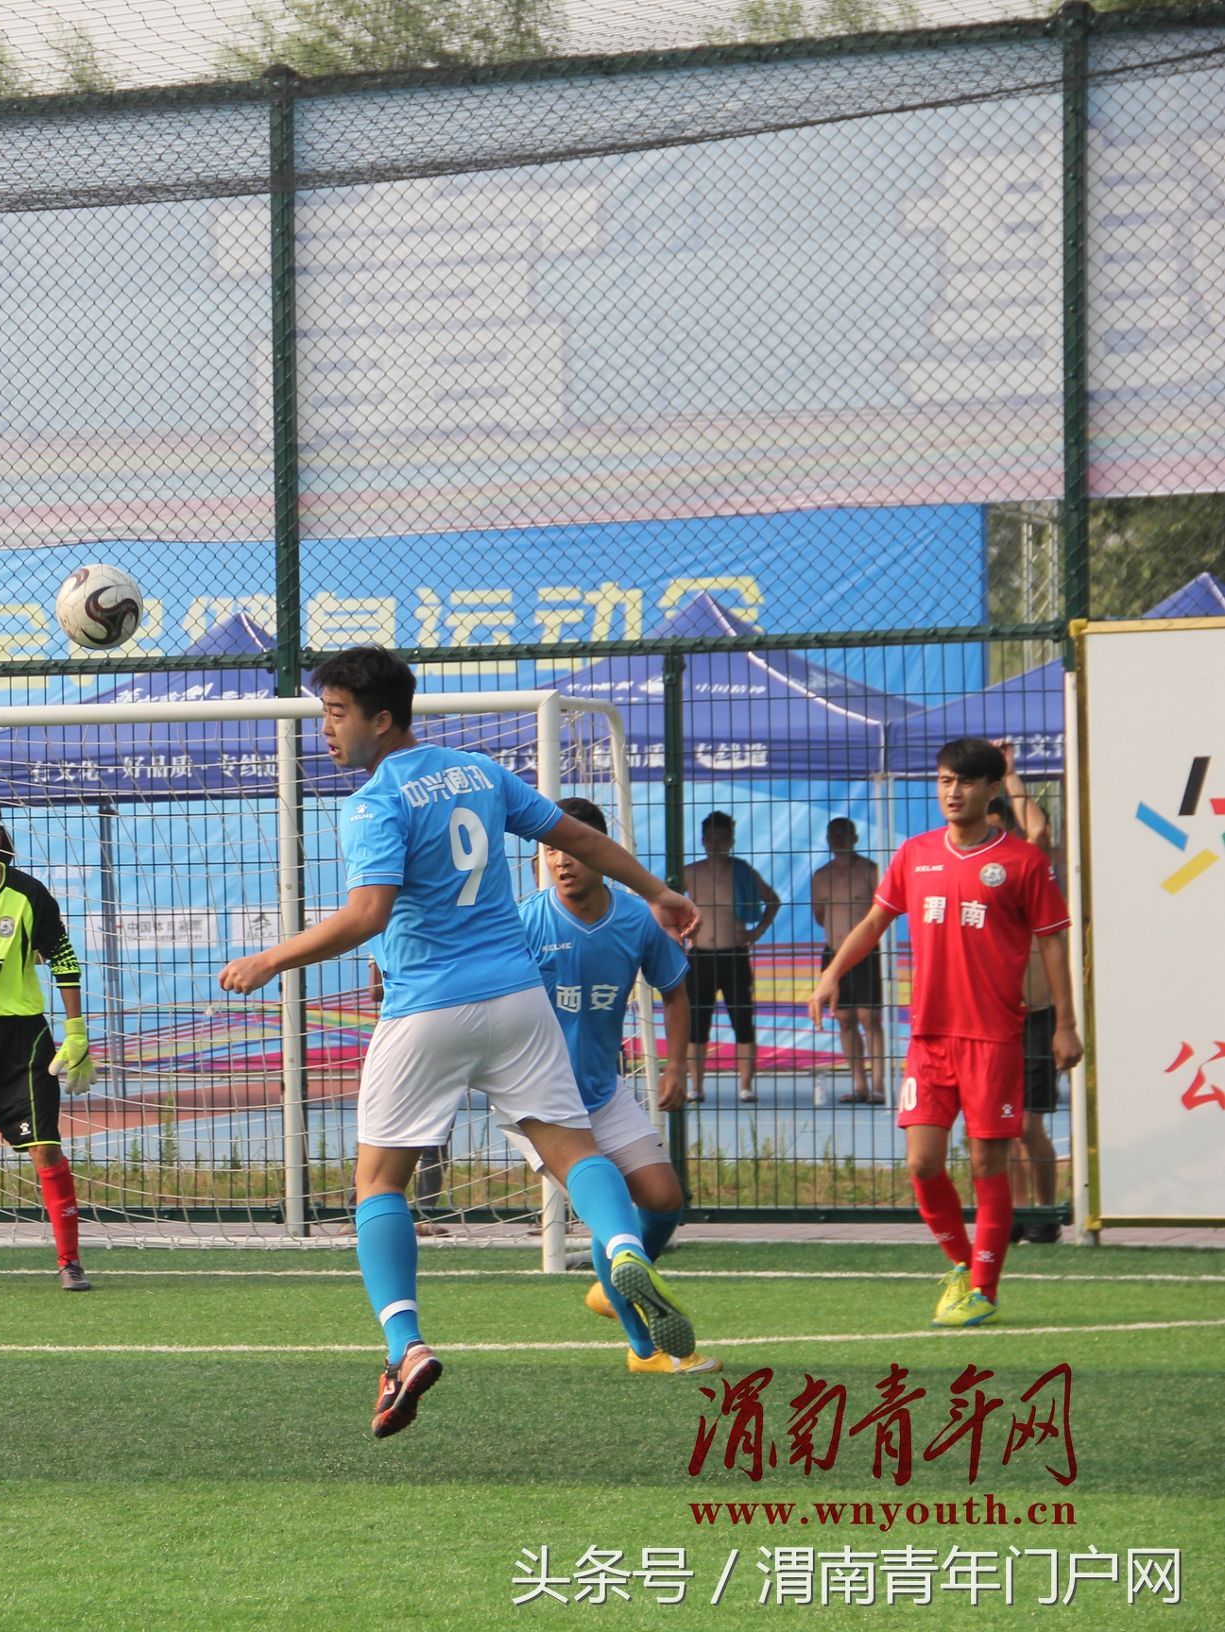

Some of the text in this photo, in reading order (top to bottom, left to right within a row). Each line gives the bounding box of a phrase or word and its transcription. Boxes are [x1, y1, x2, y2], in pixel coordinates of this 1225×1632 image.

[400, 764, 495, 809] 中兴通讯
[448, 806, 489, 907] 9
[923, 896, 987, 929] 渭南
[556, 985, 619, 1013] 西安
